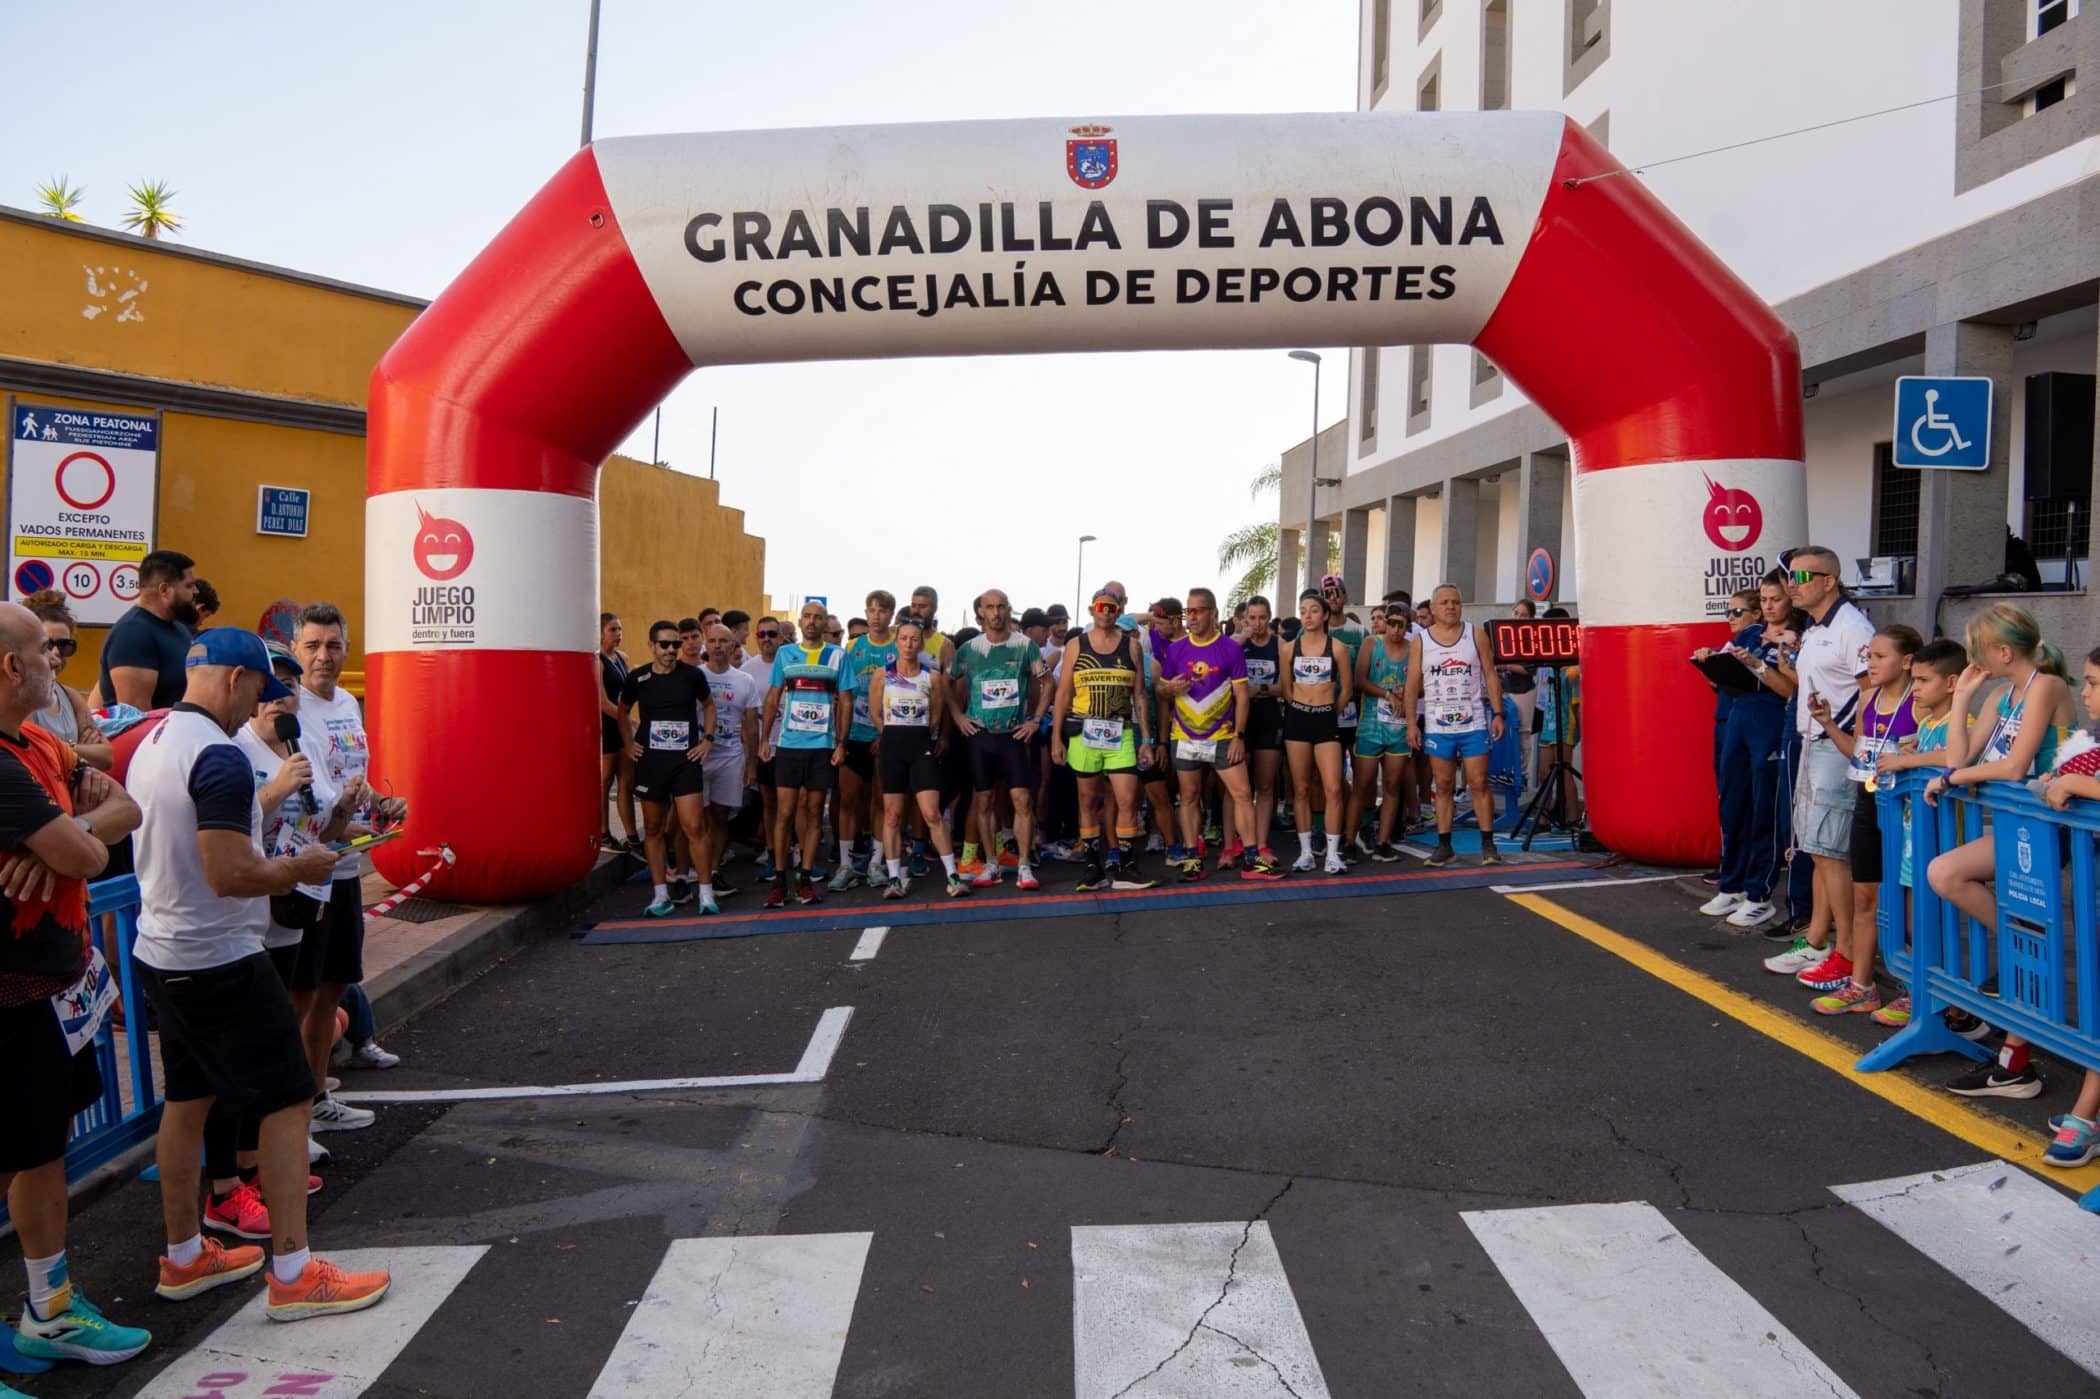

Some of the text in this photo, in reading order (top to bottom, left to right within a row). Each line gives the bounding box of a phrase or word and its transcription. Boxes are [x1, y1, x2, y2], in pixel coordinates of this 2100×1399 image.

[684, 196, 1505, 263] GRANADILLA DE ABONA
[733, 260, 1457, 318] CONCEJALÍA DE DEPORTES
[54, 413, 153, 432] ZONA PEATONAL
[68, 431, 116, 441] PEDESTRIAN
[279, 491, 300, 504] Calle
[58, 512, 111, 525] EXCEPTO
[20, 524, 145, 541] VADOS PERMANENTES
[20, 539, 69, 548] AUTORIZADO
[104, 543, 143, 552] DESCARGA
[1704, 556, 1766, 578] JUEGO
[74, 574, 91, 588] 10
[412, 586, 475, 607] JUEGO
[1705, 600, 1729, 610] dentr
[412, 606, 475, 625] LIMPIO
[412, 628, 475, 640] dentro y fuera
[1305, 665, 1320, 674] 49
[1430, 664, 1473, 677] HILERA
[992, 687, 1008, 697] 47
[902, 705, 917, 715] 81
[1291, 701, 1333, 713] NIKE PRO
[802, 710, 818, 721] 40
[1447, 712, 1463, 722] 82
[1094, 728, 1112, 738] 76
[2029, 896, 2047, 909] LOCAL
